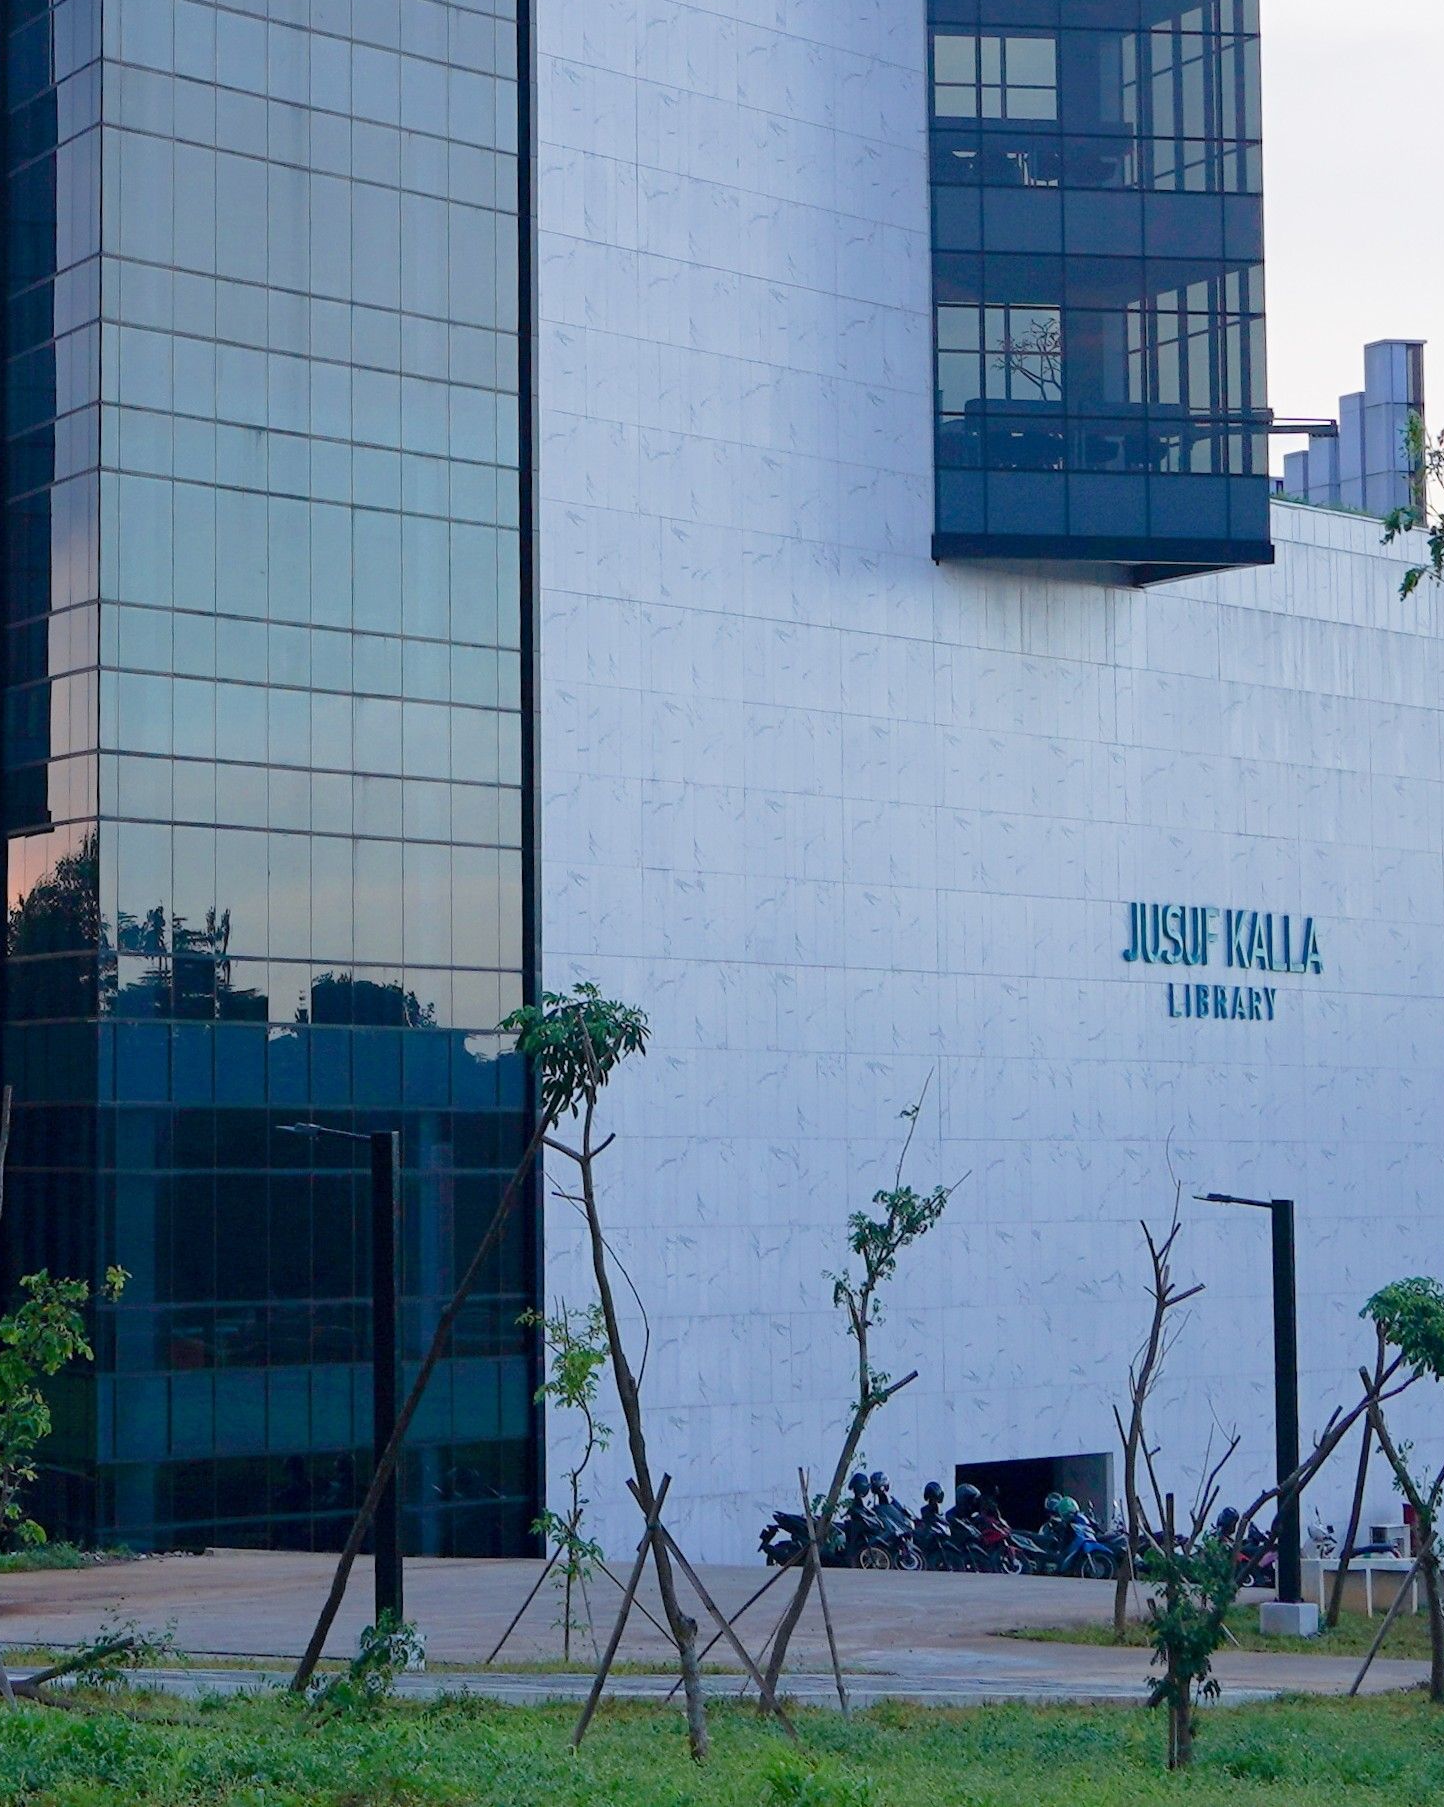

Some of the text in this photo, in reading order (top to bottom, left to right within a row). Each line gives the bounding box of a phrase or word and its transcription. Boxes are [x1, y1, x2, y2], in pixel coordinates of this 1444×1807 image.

[1122, 902, 1324, 975] JUSUF KALLA
[1168, 982, 1277, 1021] LIBRARY
